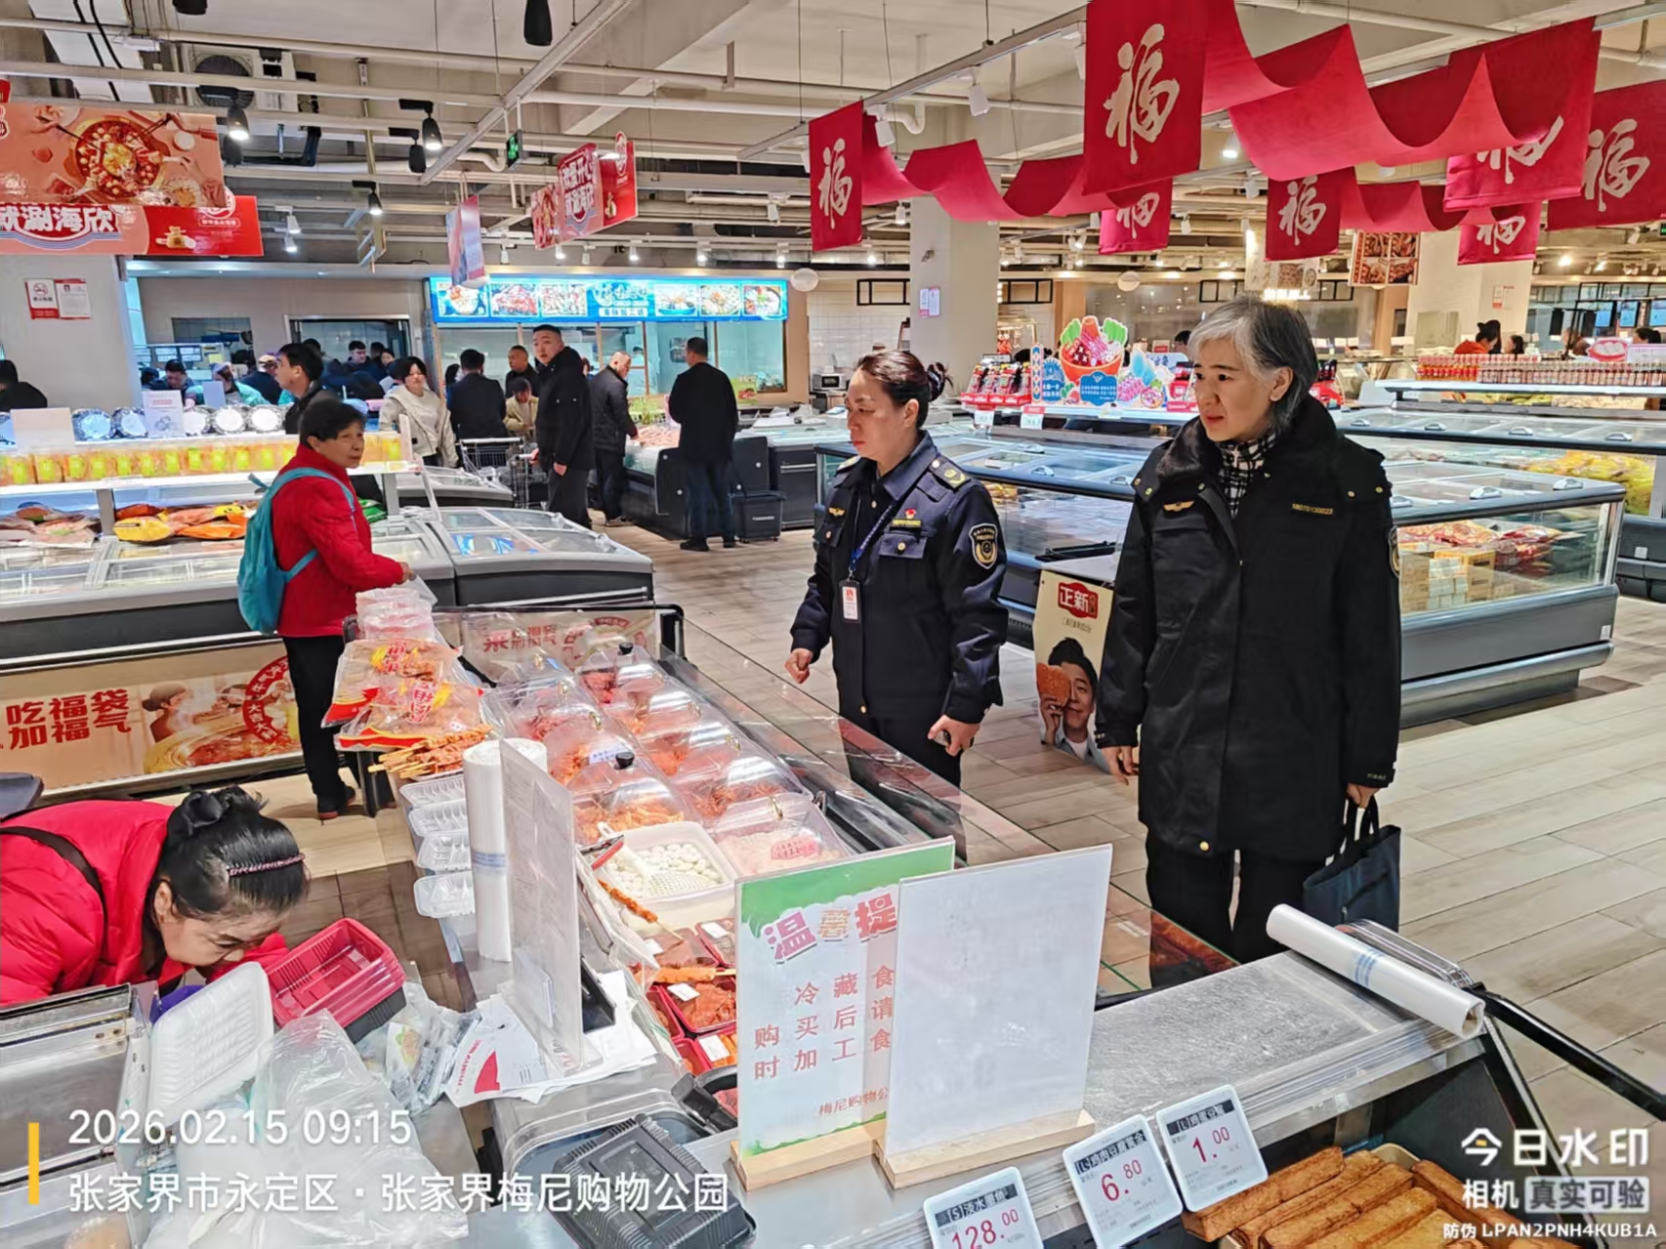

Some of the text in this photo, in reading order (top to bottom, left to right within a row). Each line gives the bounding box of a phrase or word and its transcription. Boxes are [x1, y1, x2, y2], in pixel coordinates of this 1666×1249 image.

[1104, 23, 1180, 165] 福
[818, 138, 854, 229] 福
[1583, 118, 1651, 212] 福
[1278, 176, 1327, 246] 福
[1059, 585, 1089, 614] 正新
[6, 689, 129, 725] 吃福袋
[8, 713, 132, 750] 加福气
[754, 997, 893, 1049] 购买后请
[754, 1028, 892, 1080] 时加工食
